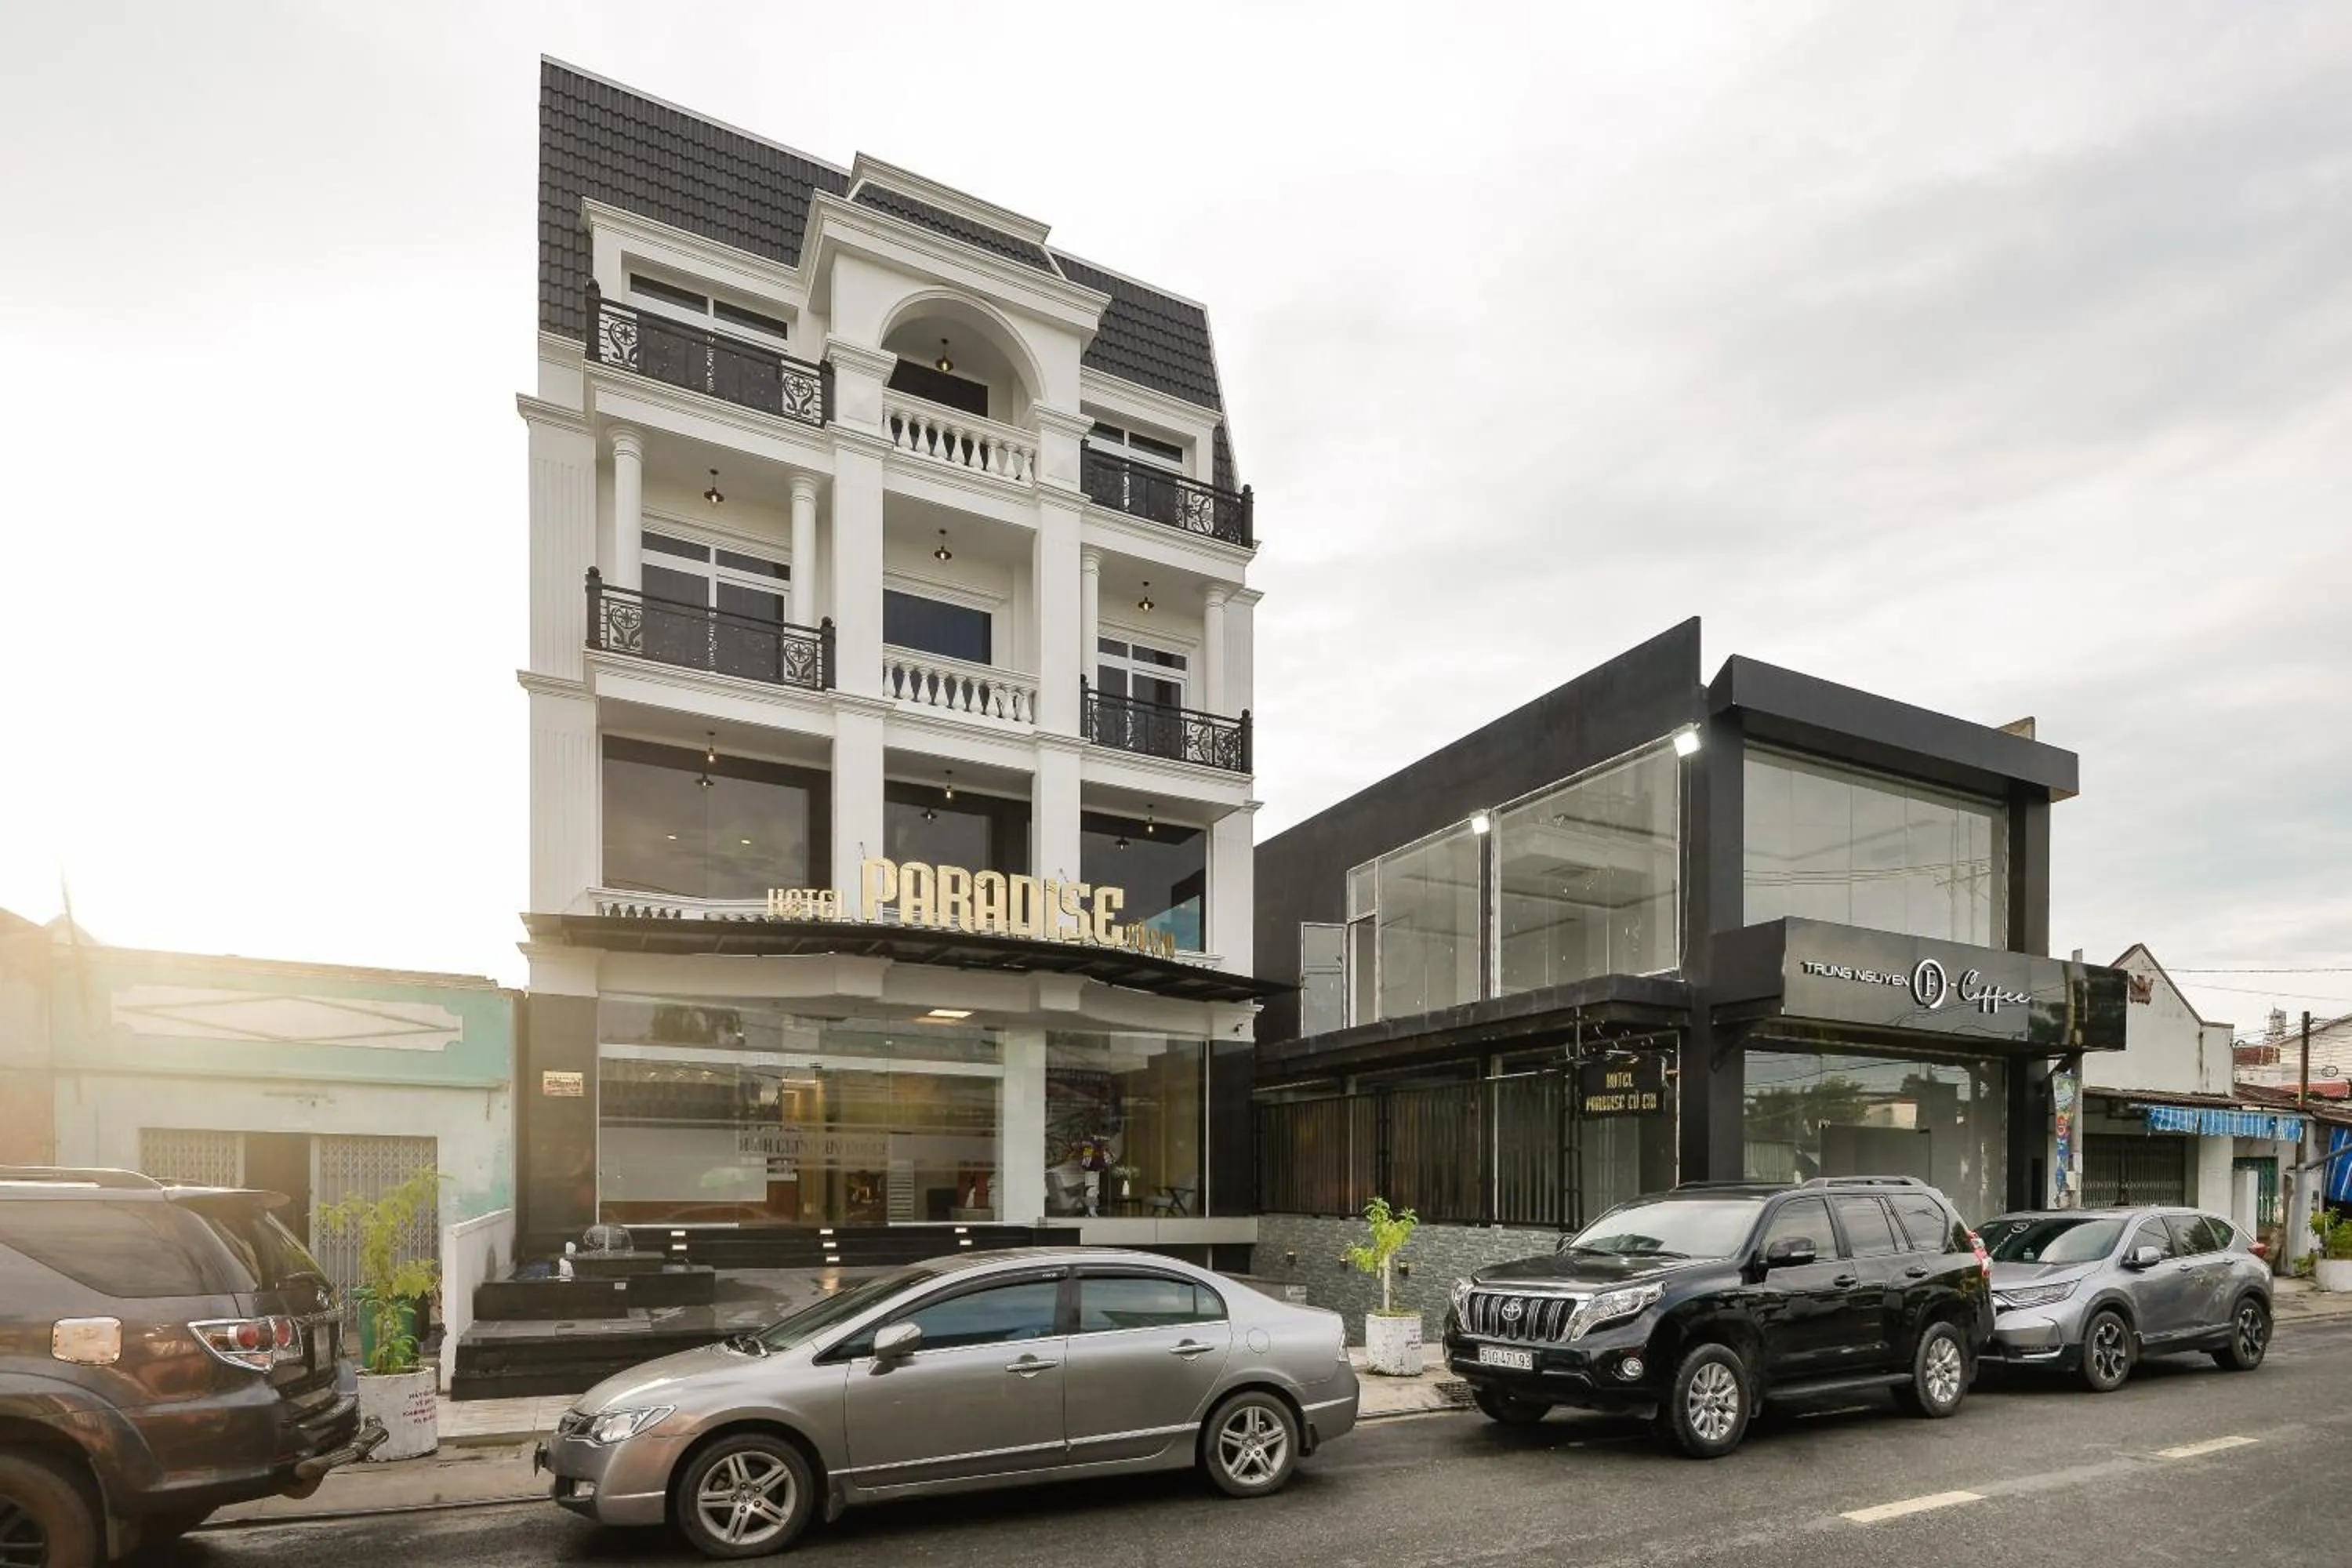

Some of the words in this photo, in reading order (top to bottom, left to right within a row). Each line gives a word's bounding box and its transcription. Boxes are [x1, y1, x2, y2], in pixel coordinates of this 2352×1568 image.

[768, 888, 844, 920] HOTEL
[862, 856, 1124, 945] PARADISE
[1804, 961, 1853, 980] TRUNG
